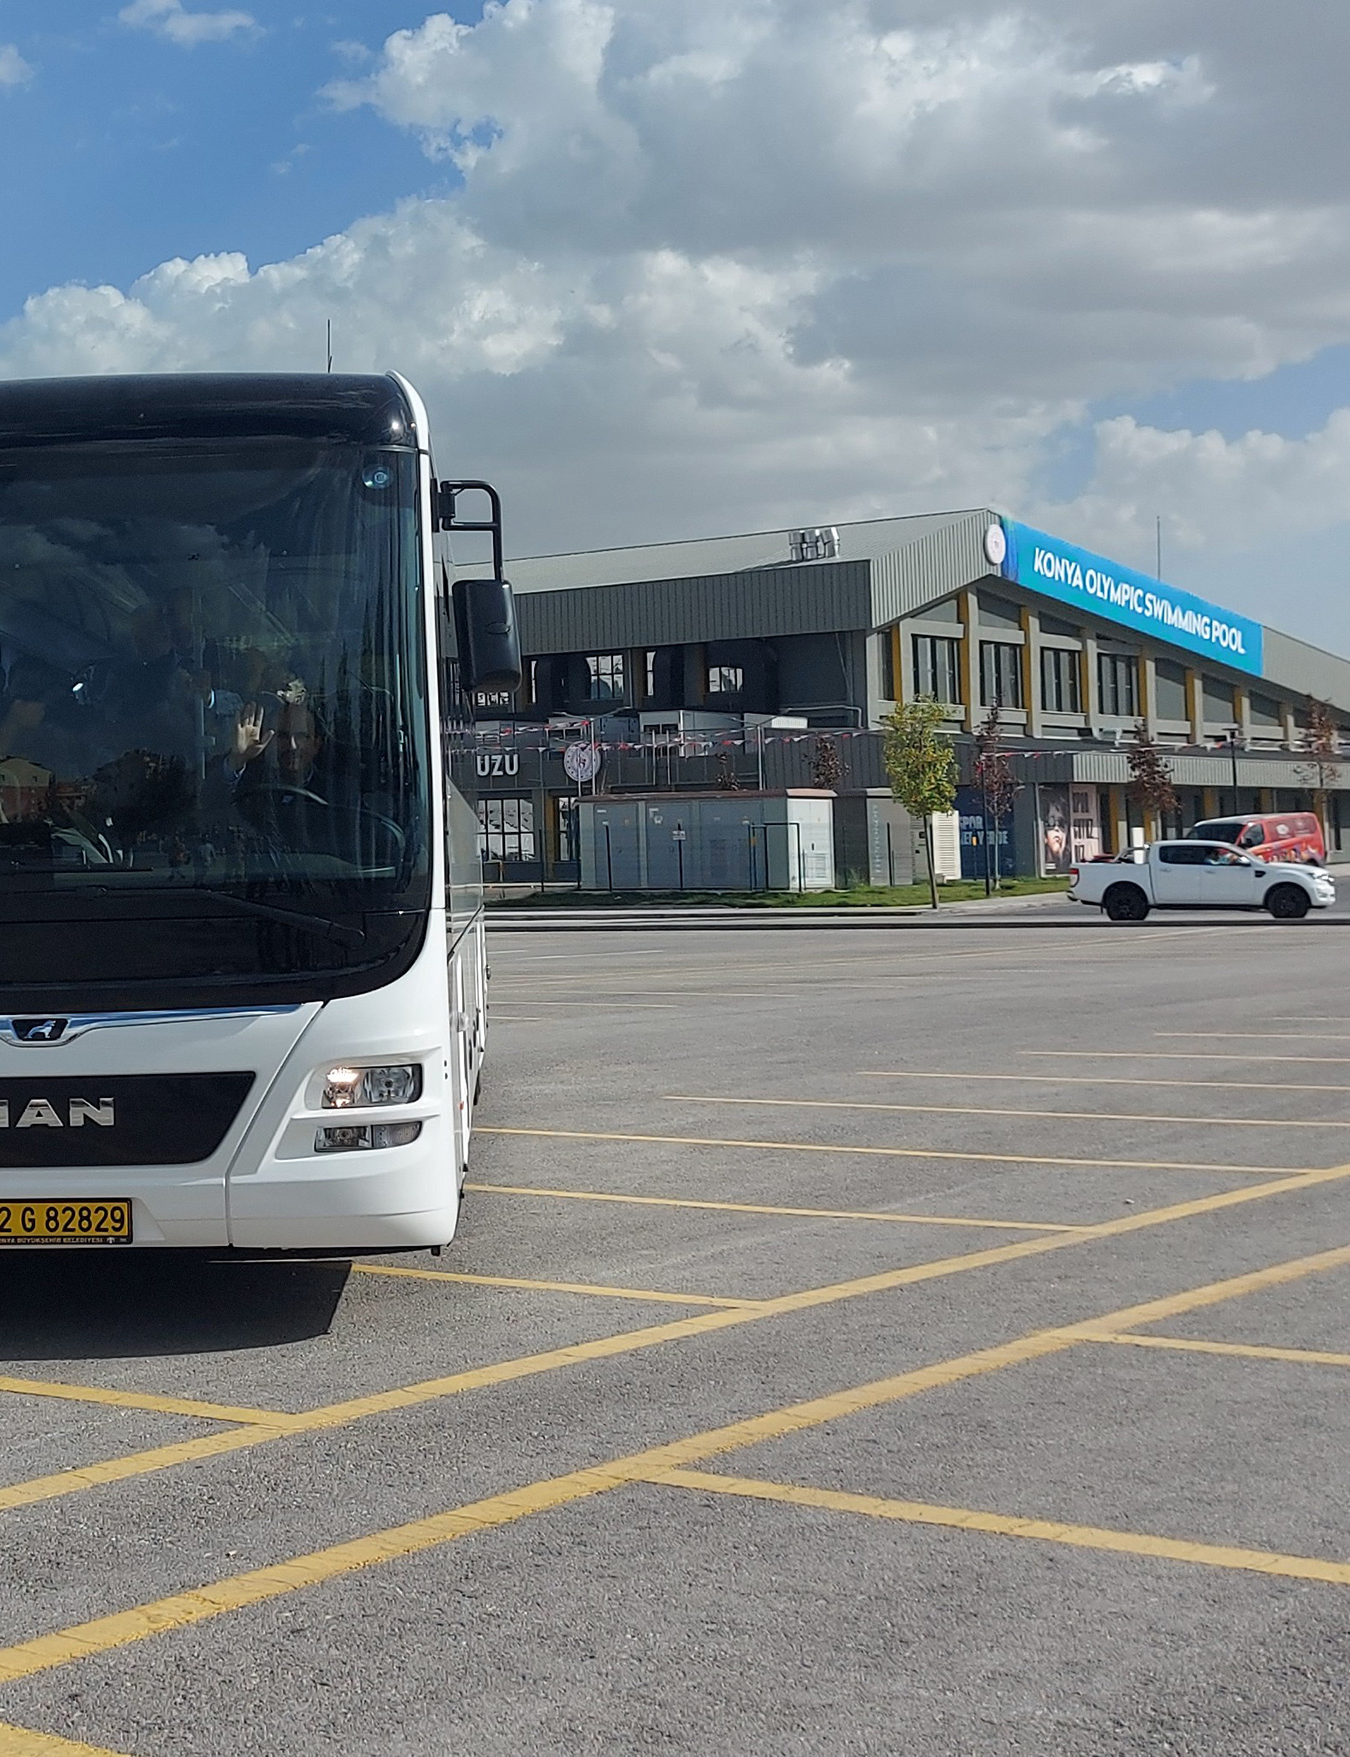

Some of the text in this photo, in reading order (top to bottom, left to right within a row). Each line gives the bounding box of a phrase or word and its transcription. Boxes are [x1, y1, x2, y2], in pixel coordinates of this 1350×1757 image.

[1034, 547, 1246, 655] KONYA OLYMPIC SWIMMING POOL
[20, 1206, 36, 1233] G
[45, 1206, 125, 1233] 82829
